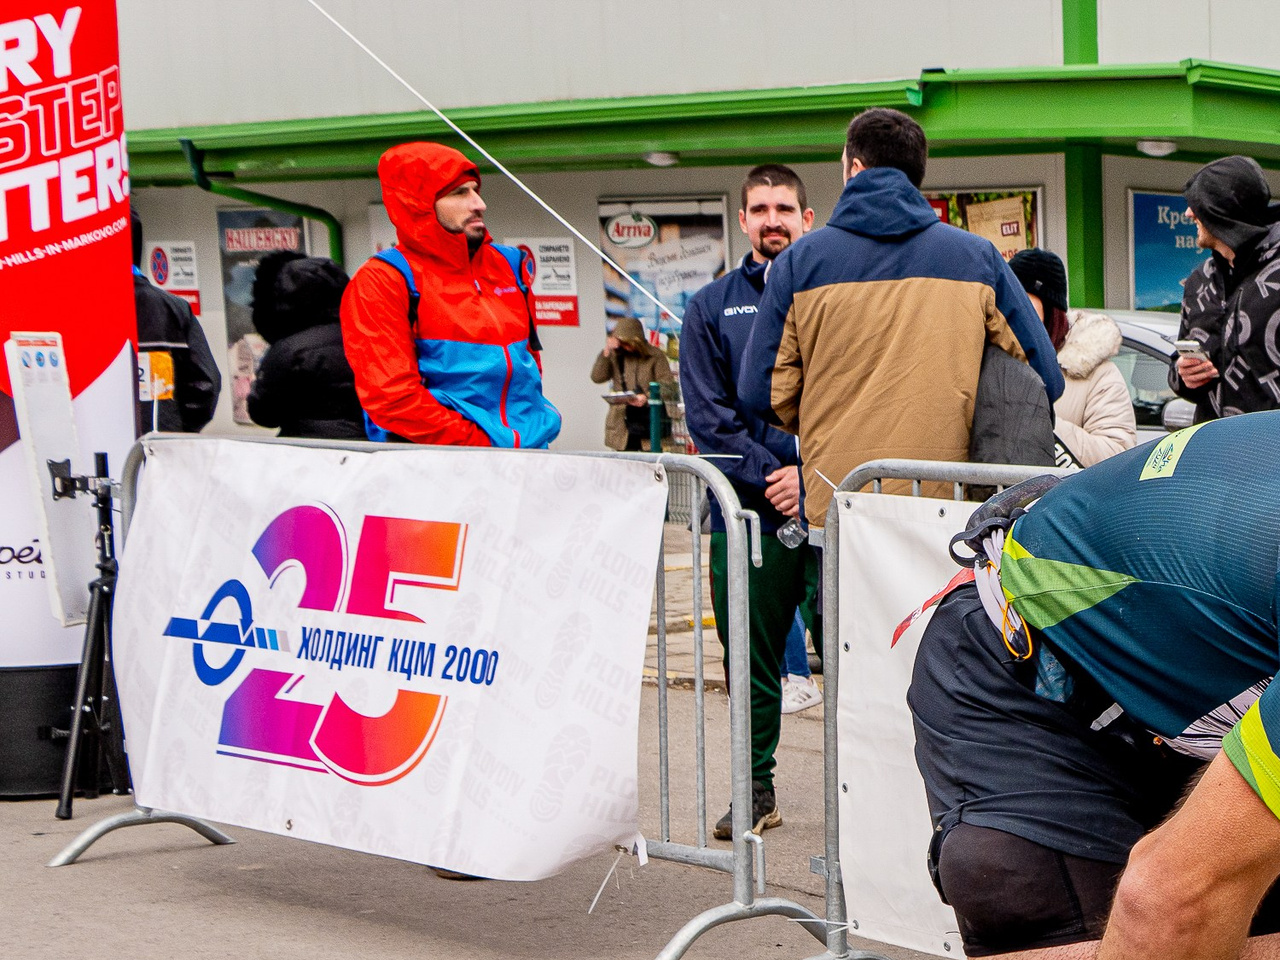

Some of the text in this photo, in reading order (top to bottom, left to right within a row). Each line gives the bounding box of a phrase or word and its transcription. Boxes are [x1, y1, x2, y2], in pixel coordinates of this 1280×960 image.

[611, 222, 652, 239] Arriva
[216, 500, 468, 786] 25
[297, 626, 384, 671] ХОЛДИНГ
[387, 638, 437, 681] КЦМ
[441, 645, 500, 686] 2000
